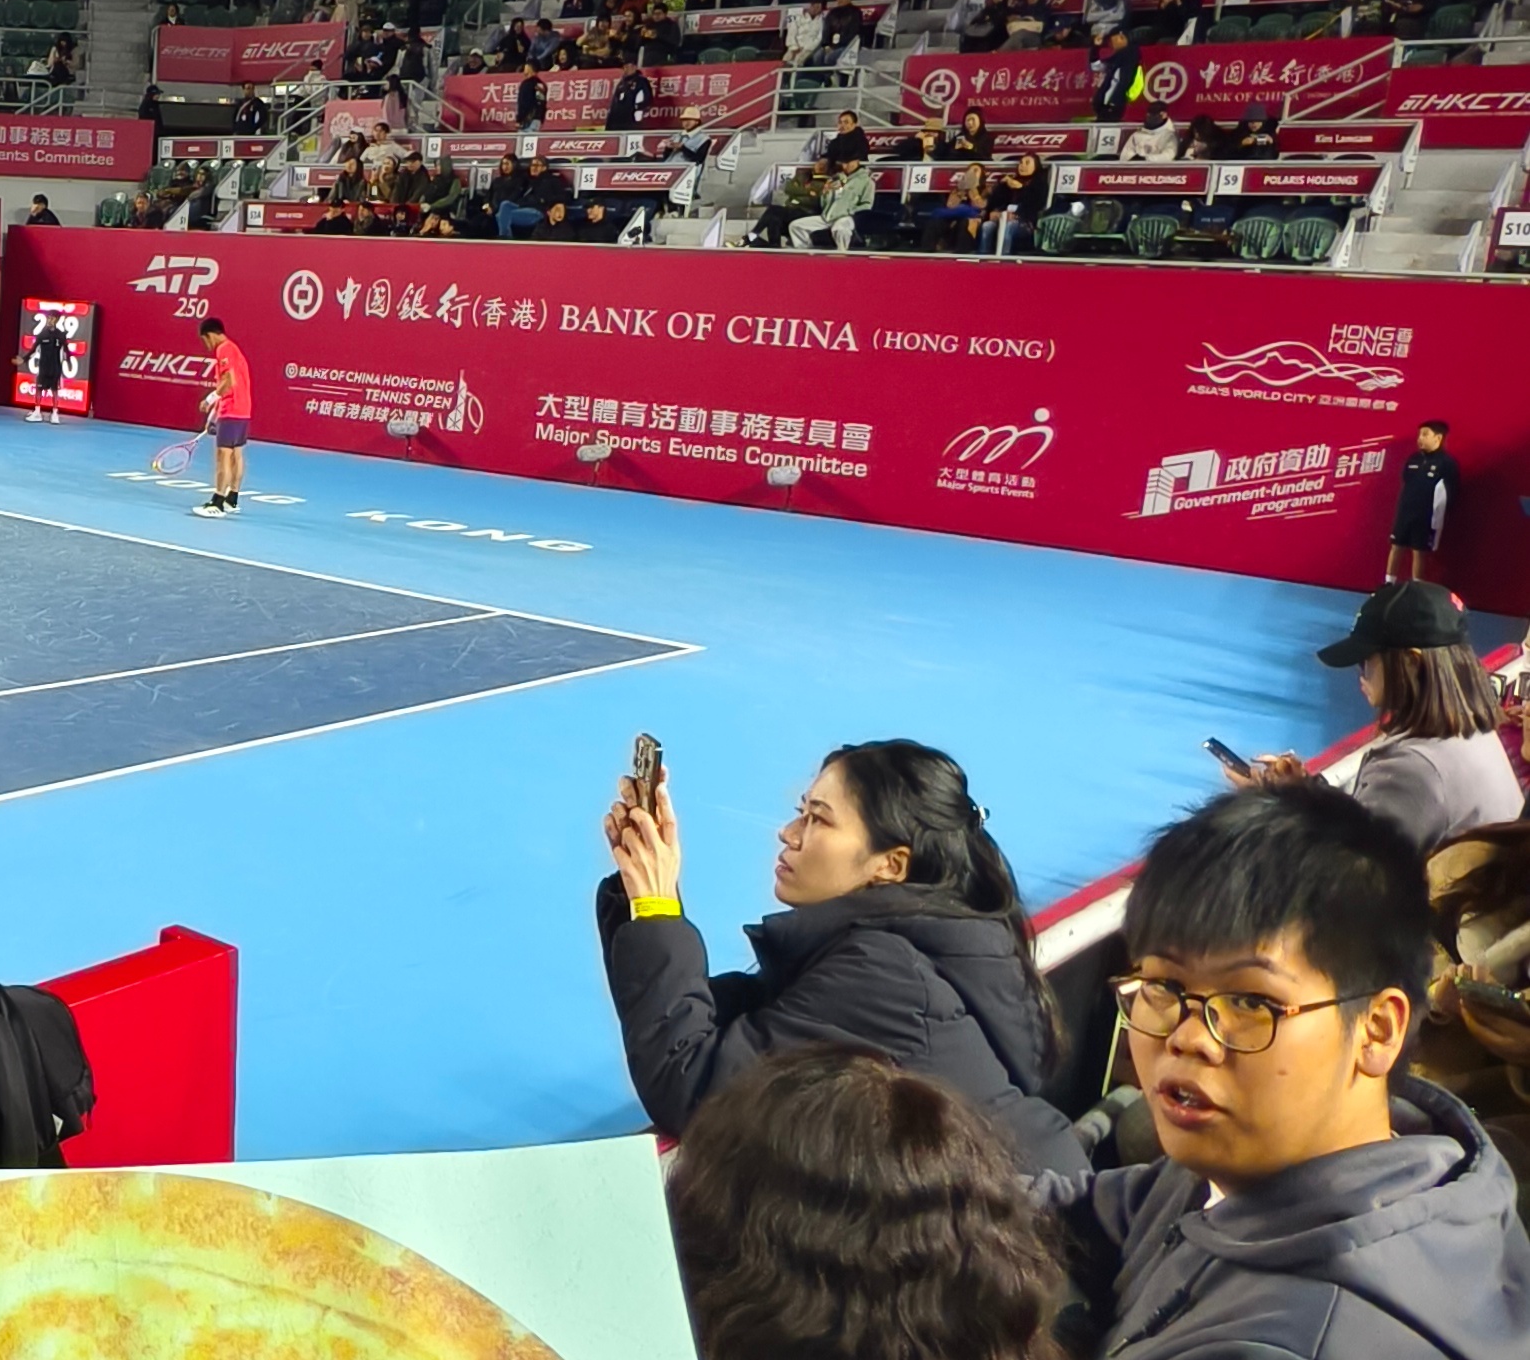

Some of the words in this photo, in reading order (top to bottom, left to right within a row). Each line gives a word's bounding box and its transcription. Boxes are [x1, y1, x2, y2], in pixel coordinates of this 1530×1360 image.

[255, 39, 336, 59] HKCTA
[34, 149, 114, 166] Committee
[913, 171, 928, 184] S6
[1060, 173, 1076, 186] S9
[1099, 174, 1135, 185] POLARIS
[1138, 174, 1187, 185] HOLDINGS
[1223, 172, 1239, 186] S9
[1263, 174, 1303, 186] POLARIS
[1306, 174, 1359, 186] HOLDINGS
[126, 255, 220, 295] ATP
[173, 297, 209, 319] 250
[559, 304, 656, 337] BANK
[666, 311, 715, 341] OF
[725, 315, 860, 353] CHINA
[872, 327, 959, 354] (HONG
[967, 336, 1056, 363] KONG)
[1331, 323, 1396, 342] HONG
[1328, 339, 1392, 357] KONG
[138, 352, 219, 378] HKCT
[299, 366, 327, 380] BANK
[329, 369, 346, 382] OF
[346, 371, 381, 386] CHINA
[382, 374, 418, 390] HONG
[419, 377, 455, 394] KONG
[365, 388, 411, 405] TENNIS
[414, 393, 453, 410] OPEN
[1187, 384, 1231, 397] ASIA'S
[1233, 388, 1281, 402] WORLD
[1283, 391, 1316, 404] CITY
[536, 393, 873, 452] 大型體育活動事務委員會
[535, 422, 589, 447] Major
[596, 429, 661, 455] Sports
[668, 437, 737, 463] Events
[744, 446, 868, 478] Committee
[1225, 443, 1332, 482] 政府資助
[1334, 448, 1387, 478] 計劃
[936, 478, 967, 490] Major
[968, 482, 1000, 494] Sports
[1001, 486, 1034, 499] Events
[1174, 476, 1325, 511] Government-funded
[1251, 491, 1336, 516] programme
[345, 509, 594, 552] KONG
